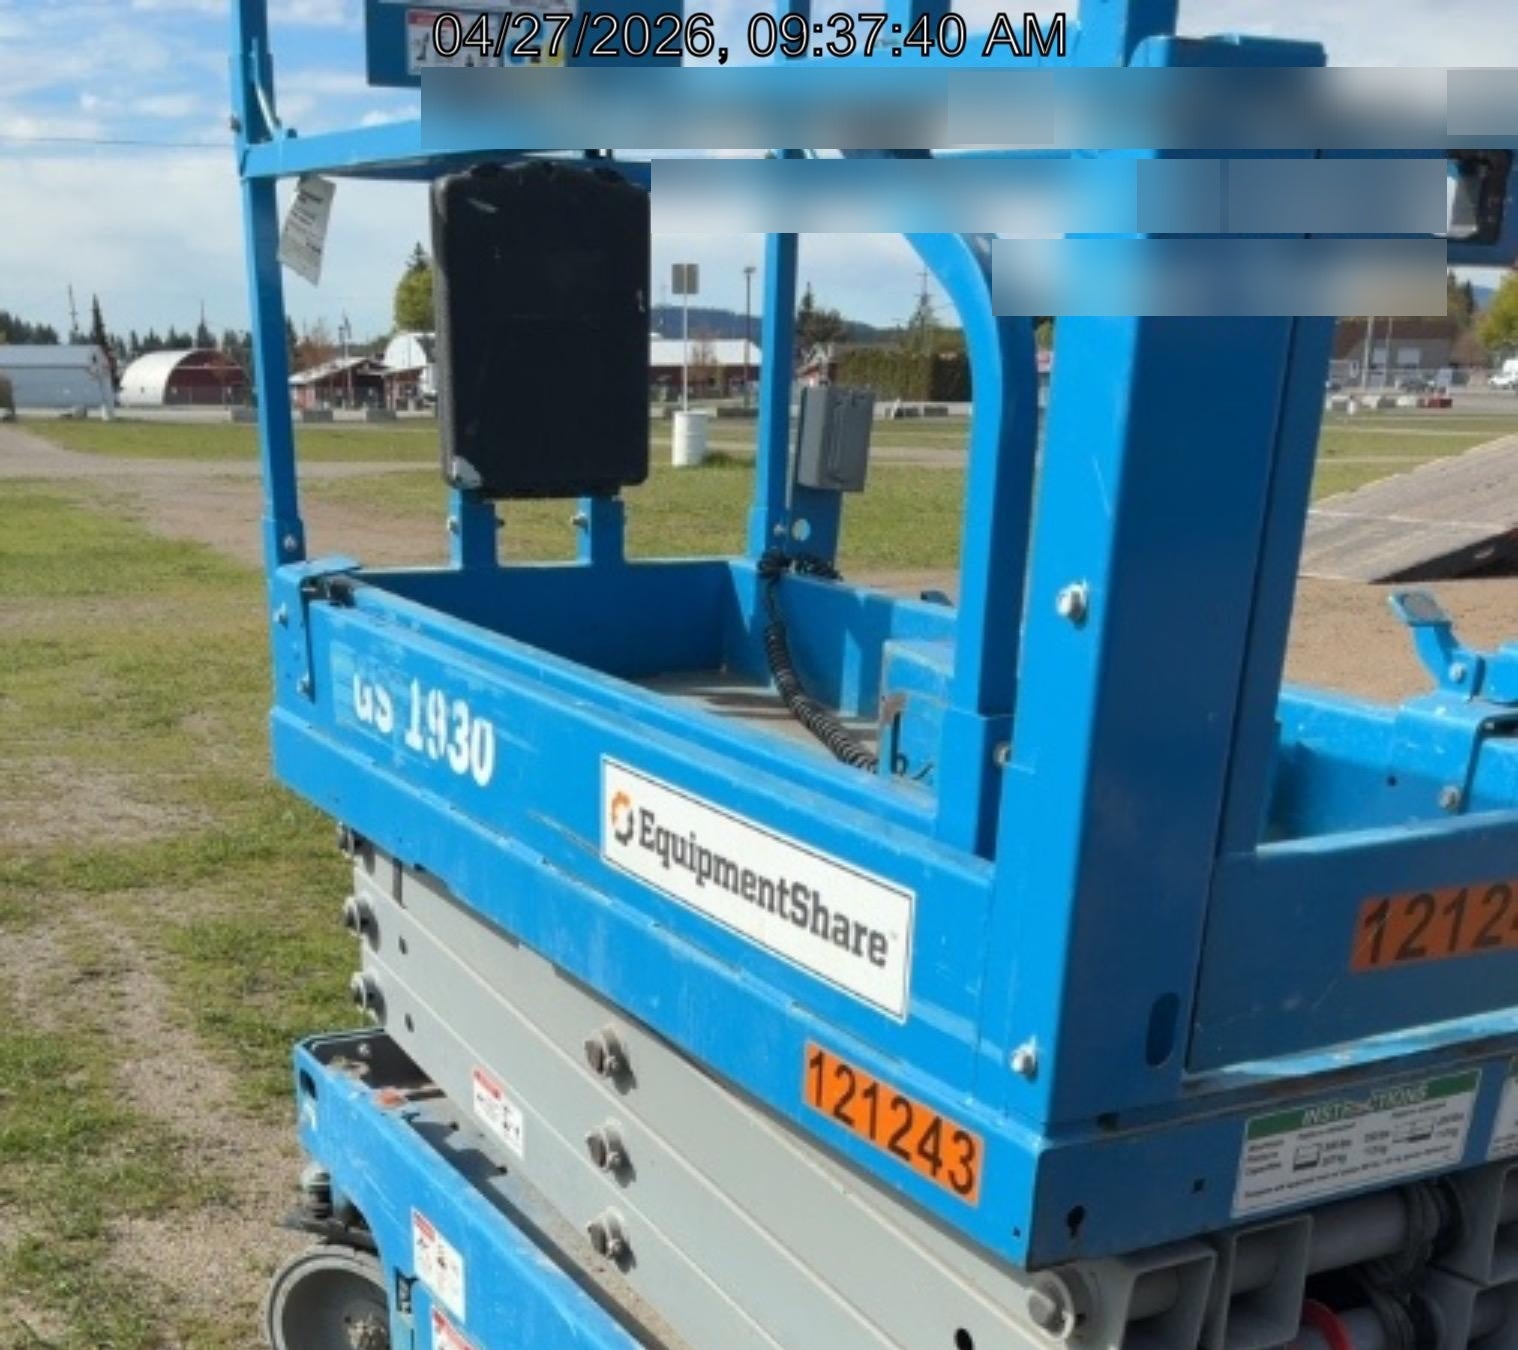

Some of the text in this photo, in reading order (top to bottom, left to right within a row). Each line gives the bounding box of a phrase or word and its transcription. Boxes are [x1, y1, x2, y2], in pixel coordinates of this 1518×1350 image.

[405, 677, 496, 788] 1930
[638, 806, 889, 968] EquipmentShare
[1364, 883, 1518, 964] 1212
[809, 1050, 976, 1194] 121243
[1301, 1085, 1427, 1127] INSTRCTIONS
